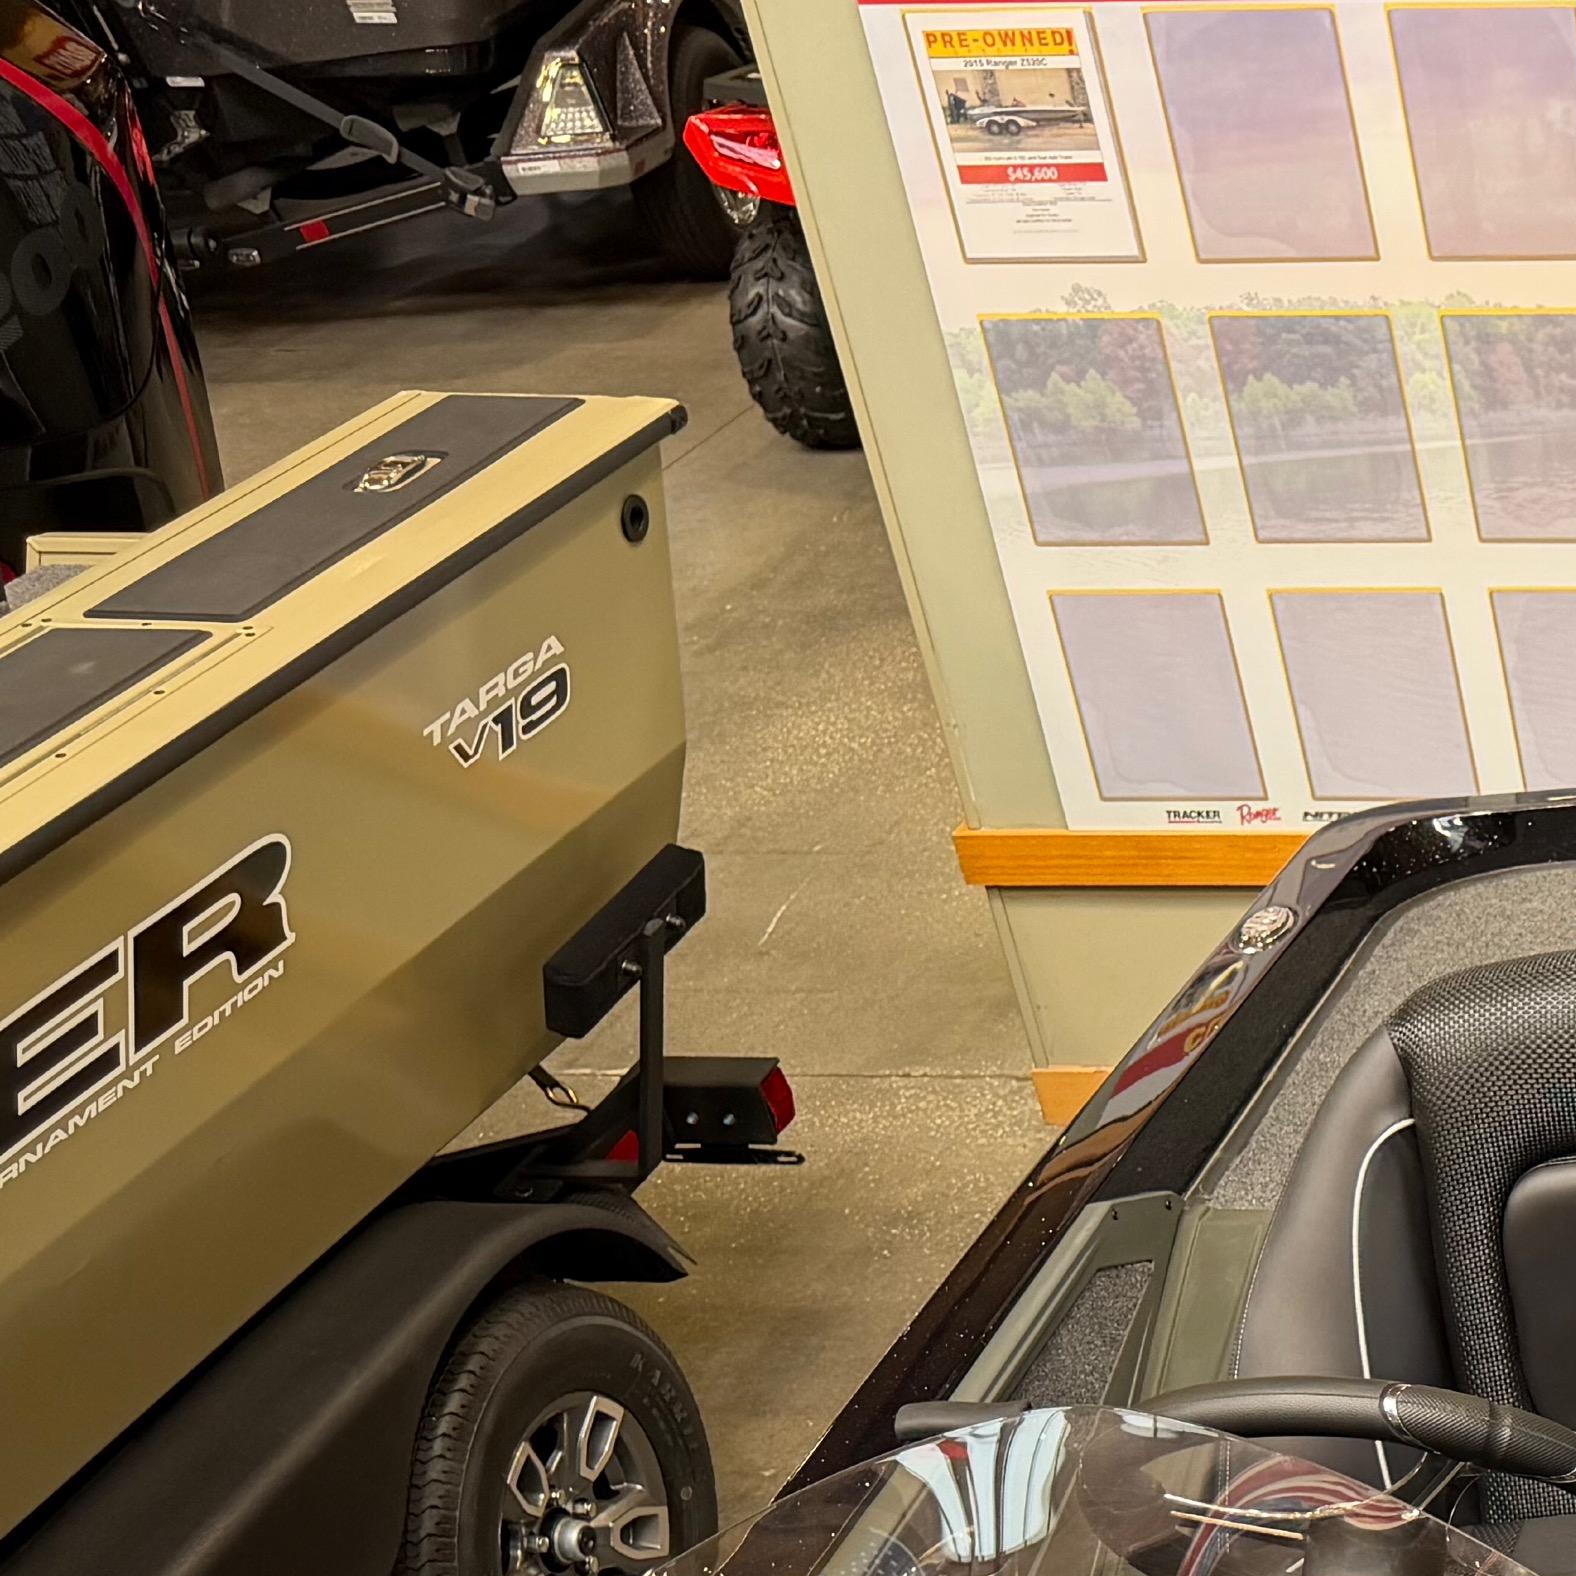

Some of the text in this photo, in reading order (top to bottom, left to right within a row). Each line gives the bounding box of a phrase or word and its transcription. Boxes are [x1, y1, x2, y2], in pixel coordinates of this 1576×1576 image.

[925, 28, 1076, 55] PRE-OWNED!
[423, 635, 565, 746] TARGA
[449, 662, 571, 768] V19
[1166, 809, 1222, 823] TRACKER
[1236, 804, 1281, 825] Ranger
[173, 960, 285, 1055] EDITION
